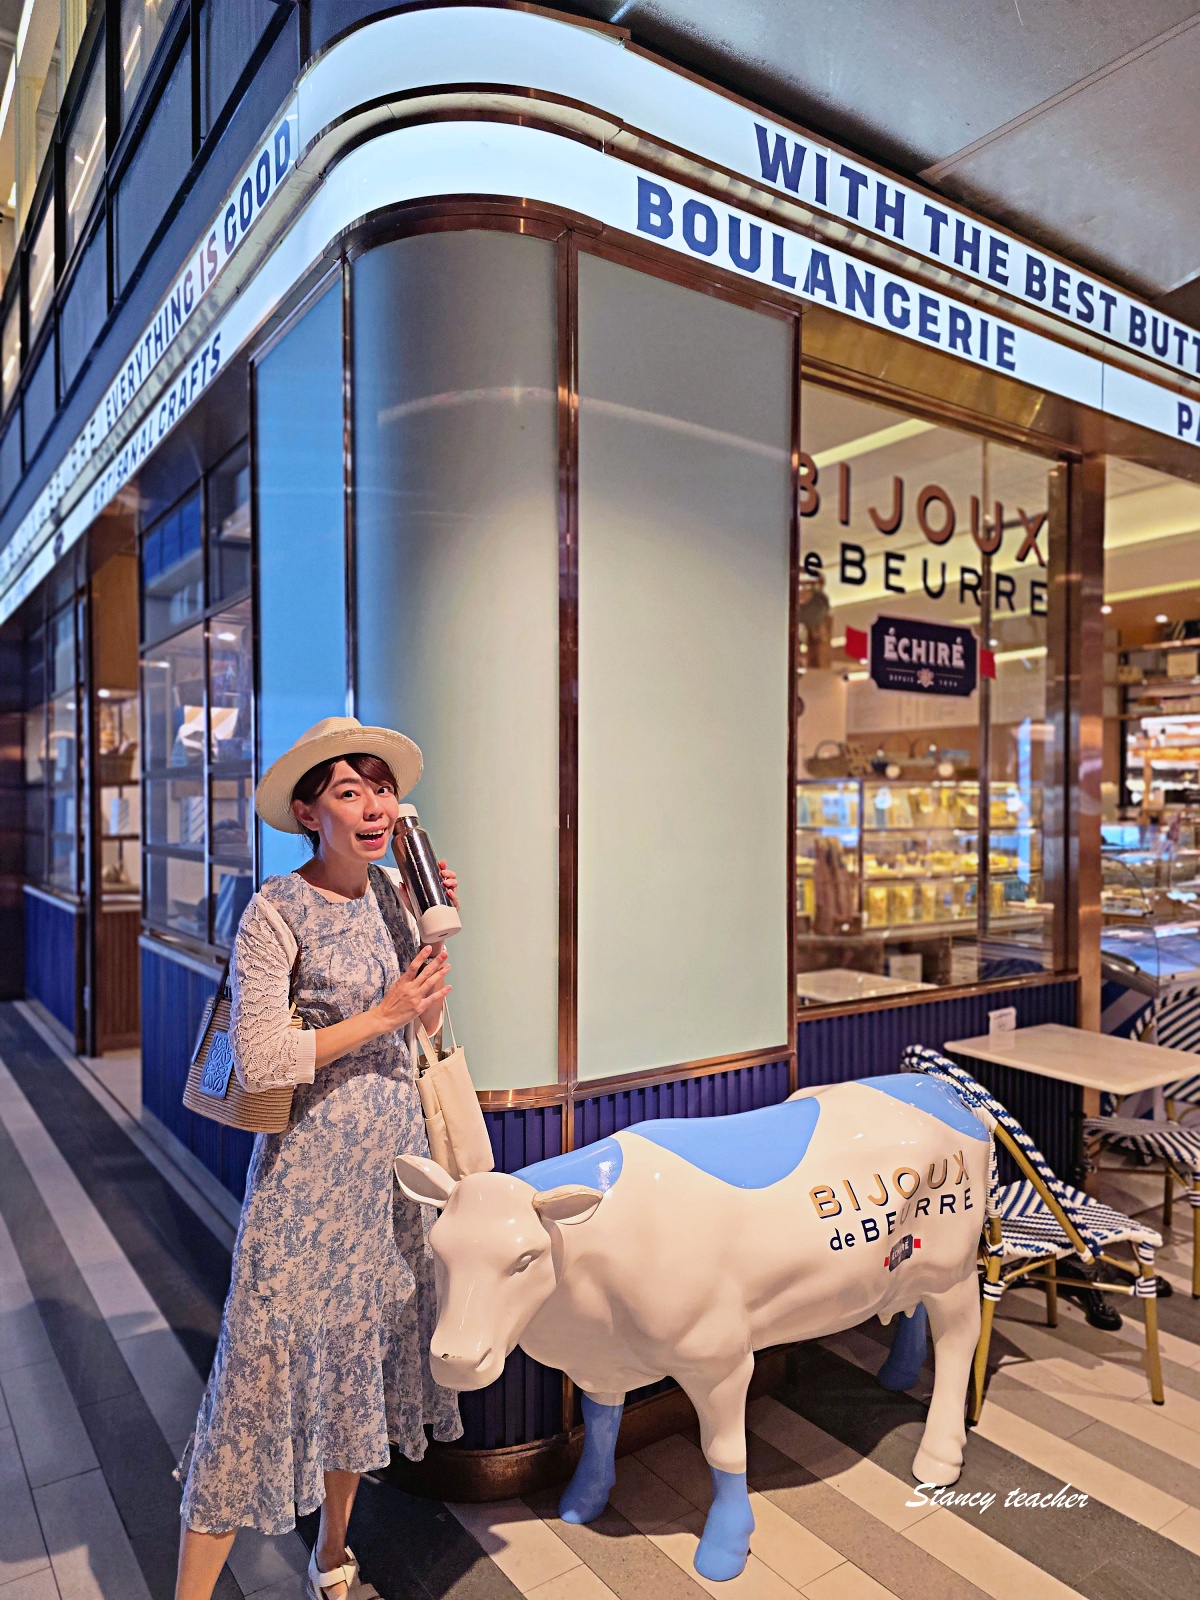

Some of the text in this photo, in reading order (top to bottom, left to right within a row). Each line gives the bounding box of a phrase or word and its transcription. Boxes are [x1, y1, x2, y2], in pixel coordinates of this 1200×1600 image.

[636, 175, 1017, 372] BOULANGERIE
[753, 122, 906, 242] WITH
[923, 203, 1010, 287] THE
[1024, 252, 1117, 334] BEST
[105, 119, 291, 430] EVERYTHING IS GOOD
[158, 331, 222, 438] CRAFTS
[840, 542, 1048, 617] BEURRE
[883, 627, 965, 669] ÉCHIRÉ
[808, 1150, 969, 1219] BIJOUX
[829, 1187, 974, 1251] de BEURRE
